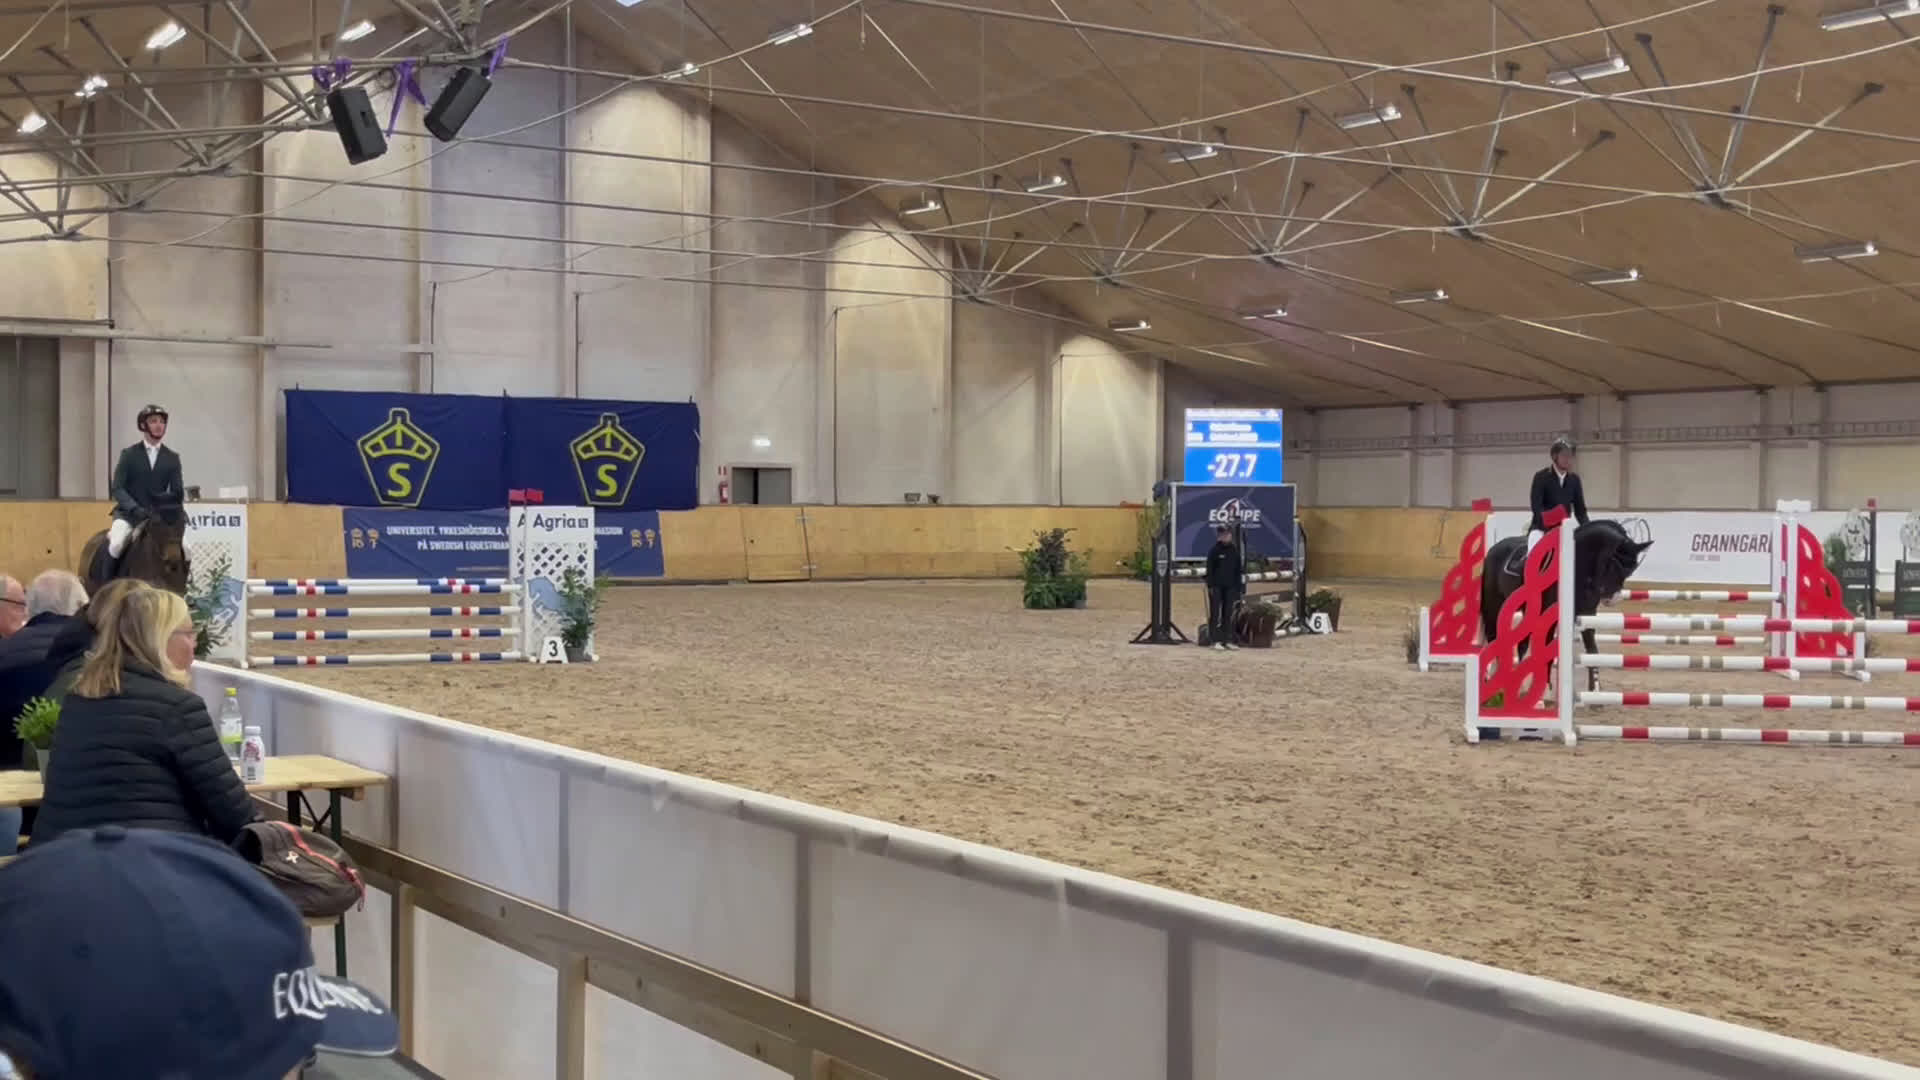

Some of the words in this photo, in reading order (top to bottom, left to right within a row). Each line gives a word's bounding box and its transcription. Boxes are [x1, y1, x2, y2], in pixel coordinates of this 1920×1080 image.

[1207, 453, 1258, 478] -27.7
[387, 463, 412, 498] S
[595, 463, 618, 497] S
[533, 513, 576, 531] Agria
[1313, 616, 1322, 629] 6
[548, 640, 558, 657] 3
